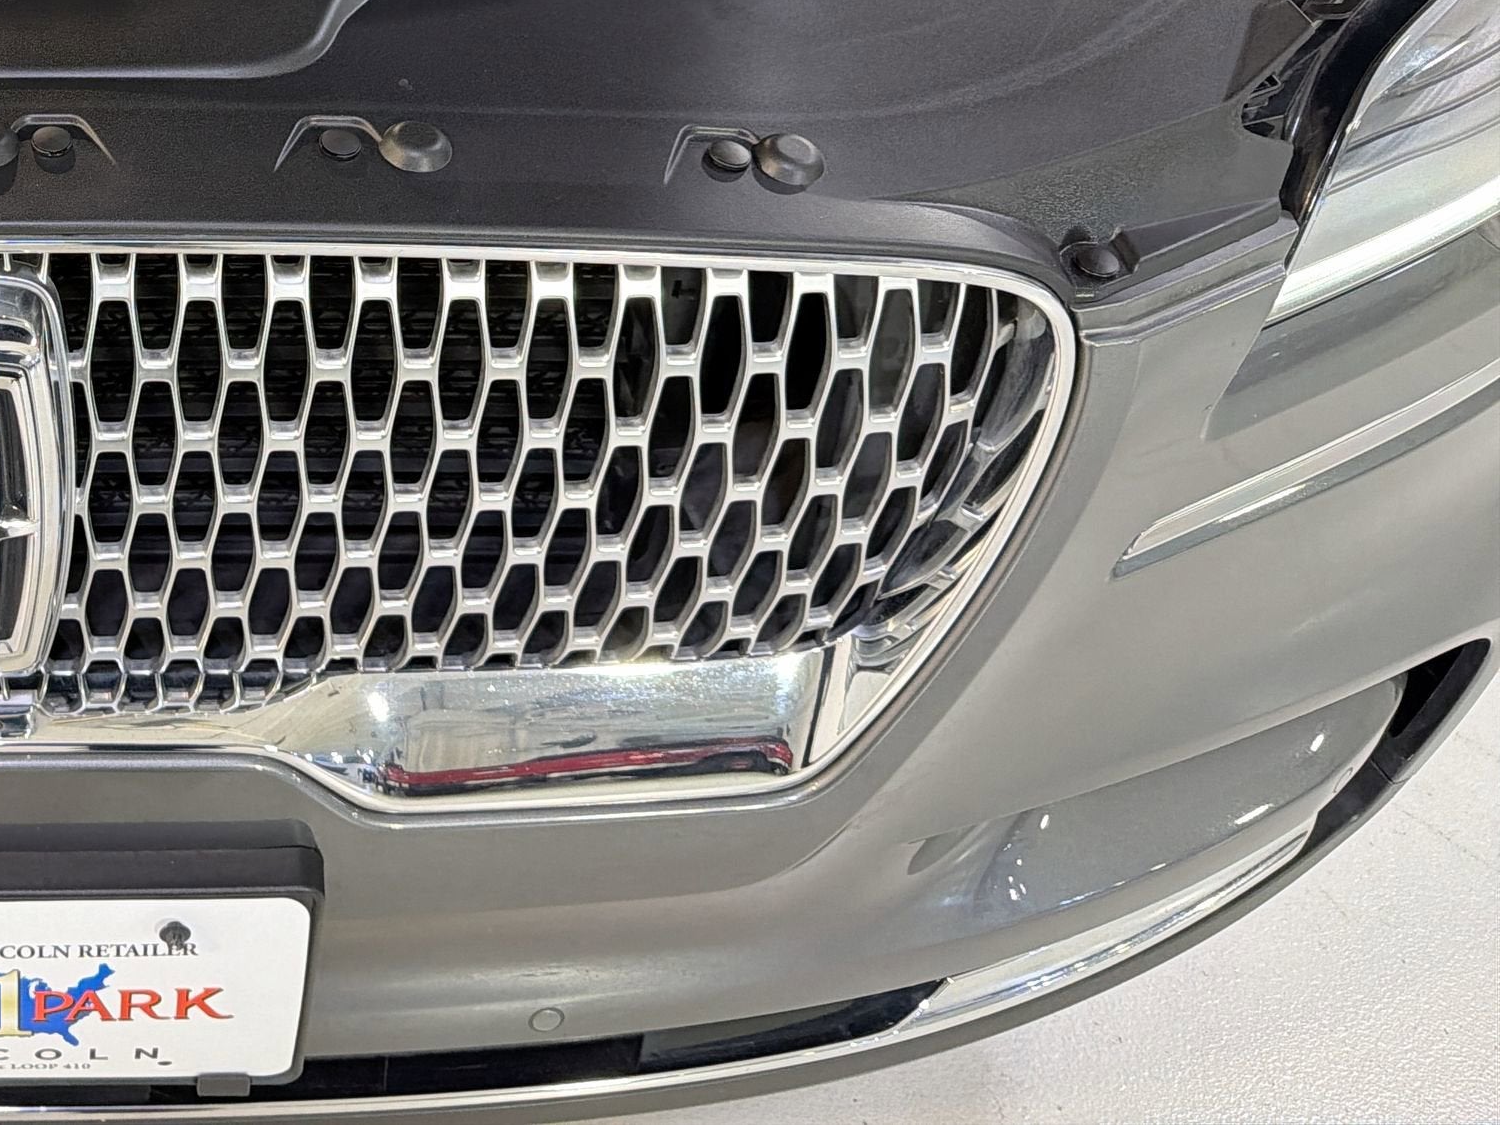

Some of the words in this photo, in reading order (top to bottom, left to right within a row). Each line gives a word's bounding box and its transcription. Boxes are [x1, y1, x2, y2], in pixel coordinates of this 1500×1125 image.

[31, 987, 235, 1023] PARK
[10, 1062, 58, 1070] LOOP
[63, 1062, 91, 1070] 410
